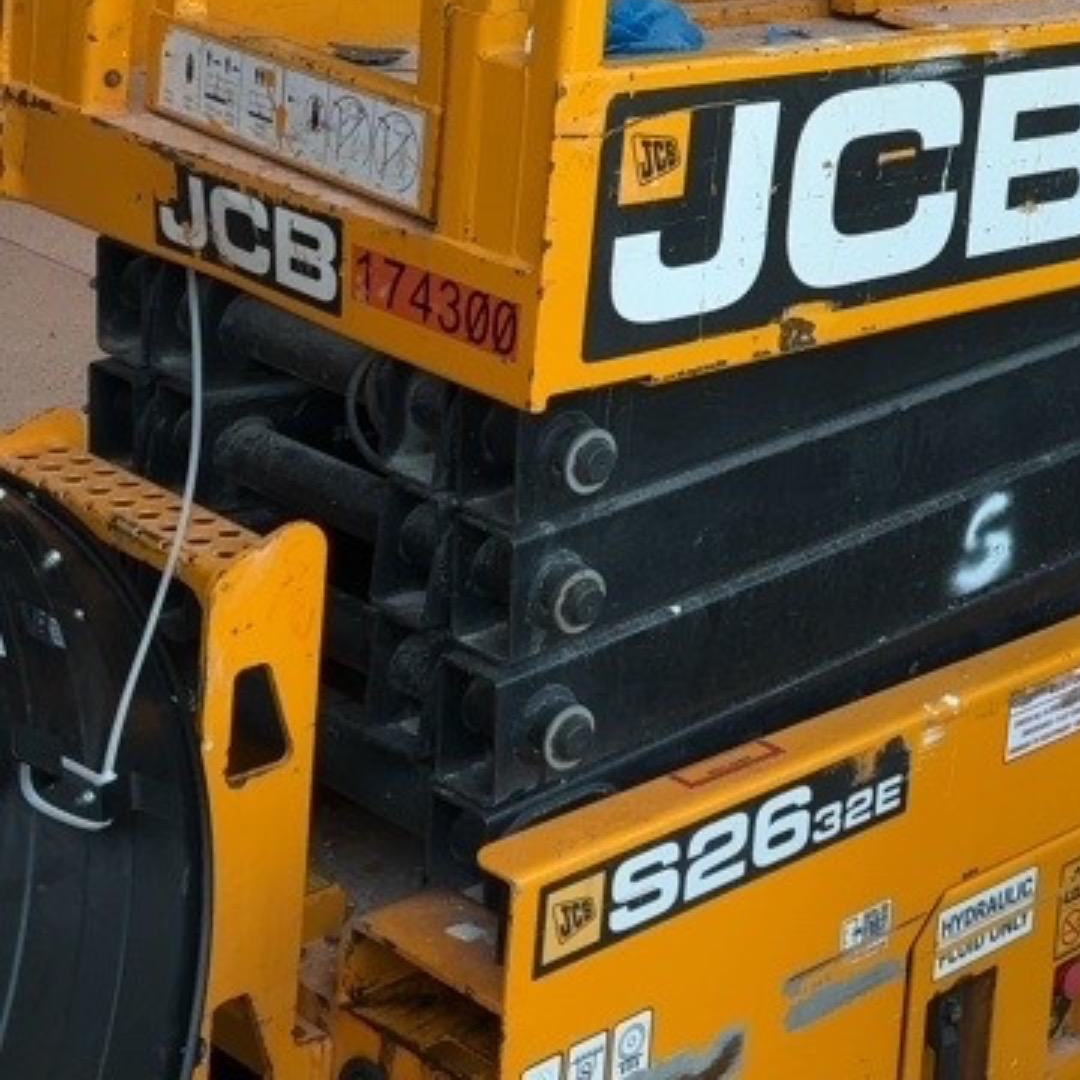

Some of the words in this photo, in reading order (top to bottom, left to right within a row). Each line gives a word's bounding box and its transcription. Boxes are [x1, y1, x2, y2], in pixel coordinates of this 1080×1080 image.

[641, 139, 676, 178] JCB
[159, 174, 337, 303] JCB
[355, 248, 521, 356] 174300
[941, 876, 1034, 939] HYDRAULIC
